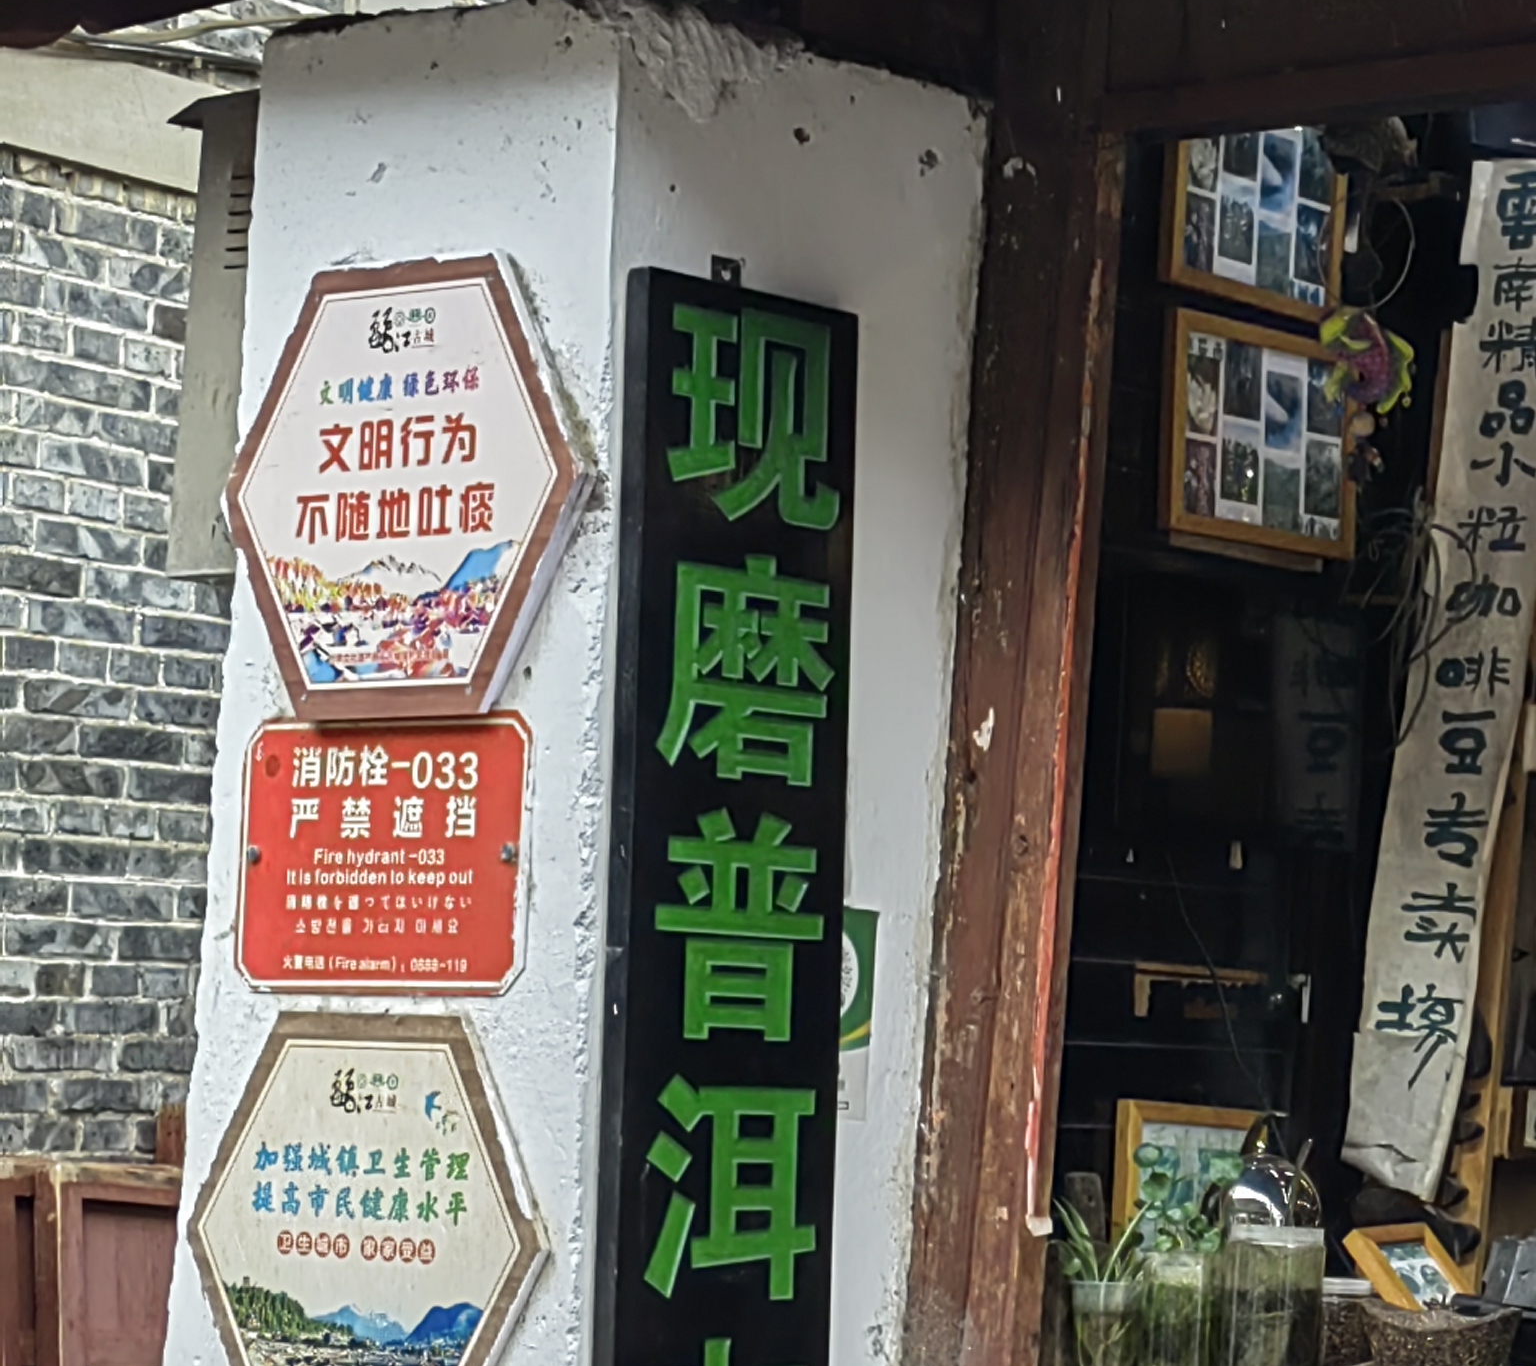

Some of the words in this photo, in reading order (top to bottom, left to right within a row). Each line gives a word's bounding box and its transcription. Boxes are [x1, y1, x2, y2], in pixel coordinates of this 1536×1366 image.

[318, 373, 393, 406] 文明健康
[402, 366, 481, 400] 绿色环保
[318, 412, 477, 474] 文明行为
[294, 481, 495, 545] 不随地吐痰
[292, 745, 479, 791] 消防栓-033
[289, 795, 477, 839] 严禁遮挡
[287, 869, 297, 885] It
[299, 869, 311, 885] is
[314, 869, 387, 885] forbidden
[391, 869, 405, 885] to
[408, 870, 445, 888] keep
[449, 870, 473, 885] out
[314, 848, 343, 865] Fire
[347, 848, 405, 867] hydrant
[253, 1141, 471, 1181] 加强城镇卫生管理
[252, 1181, 468, 1226] 提高市民健康水平
